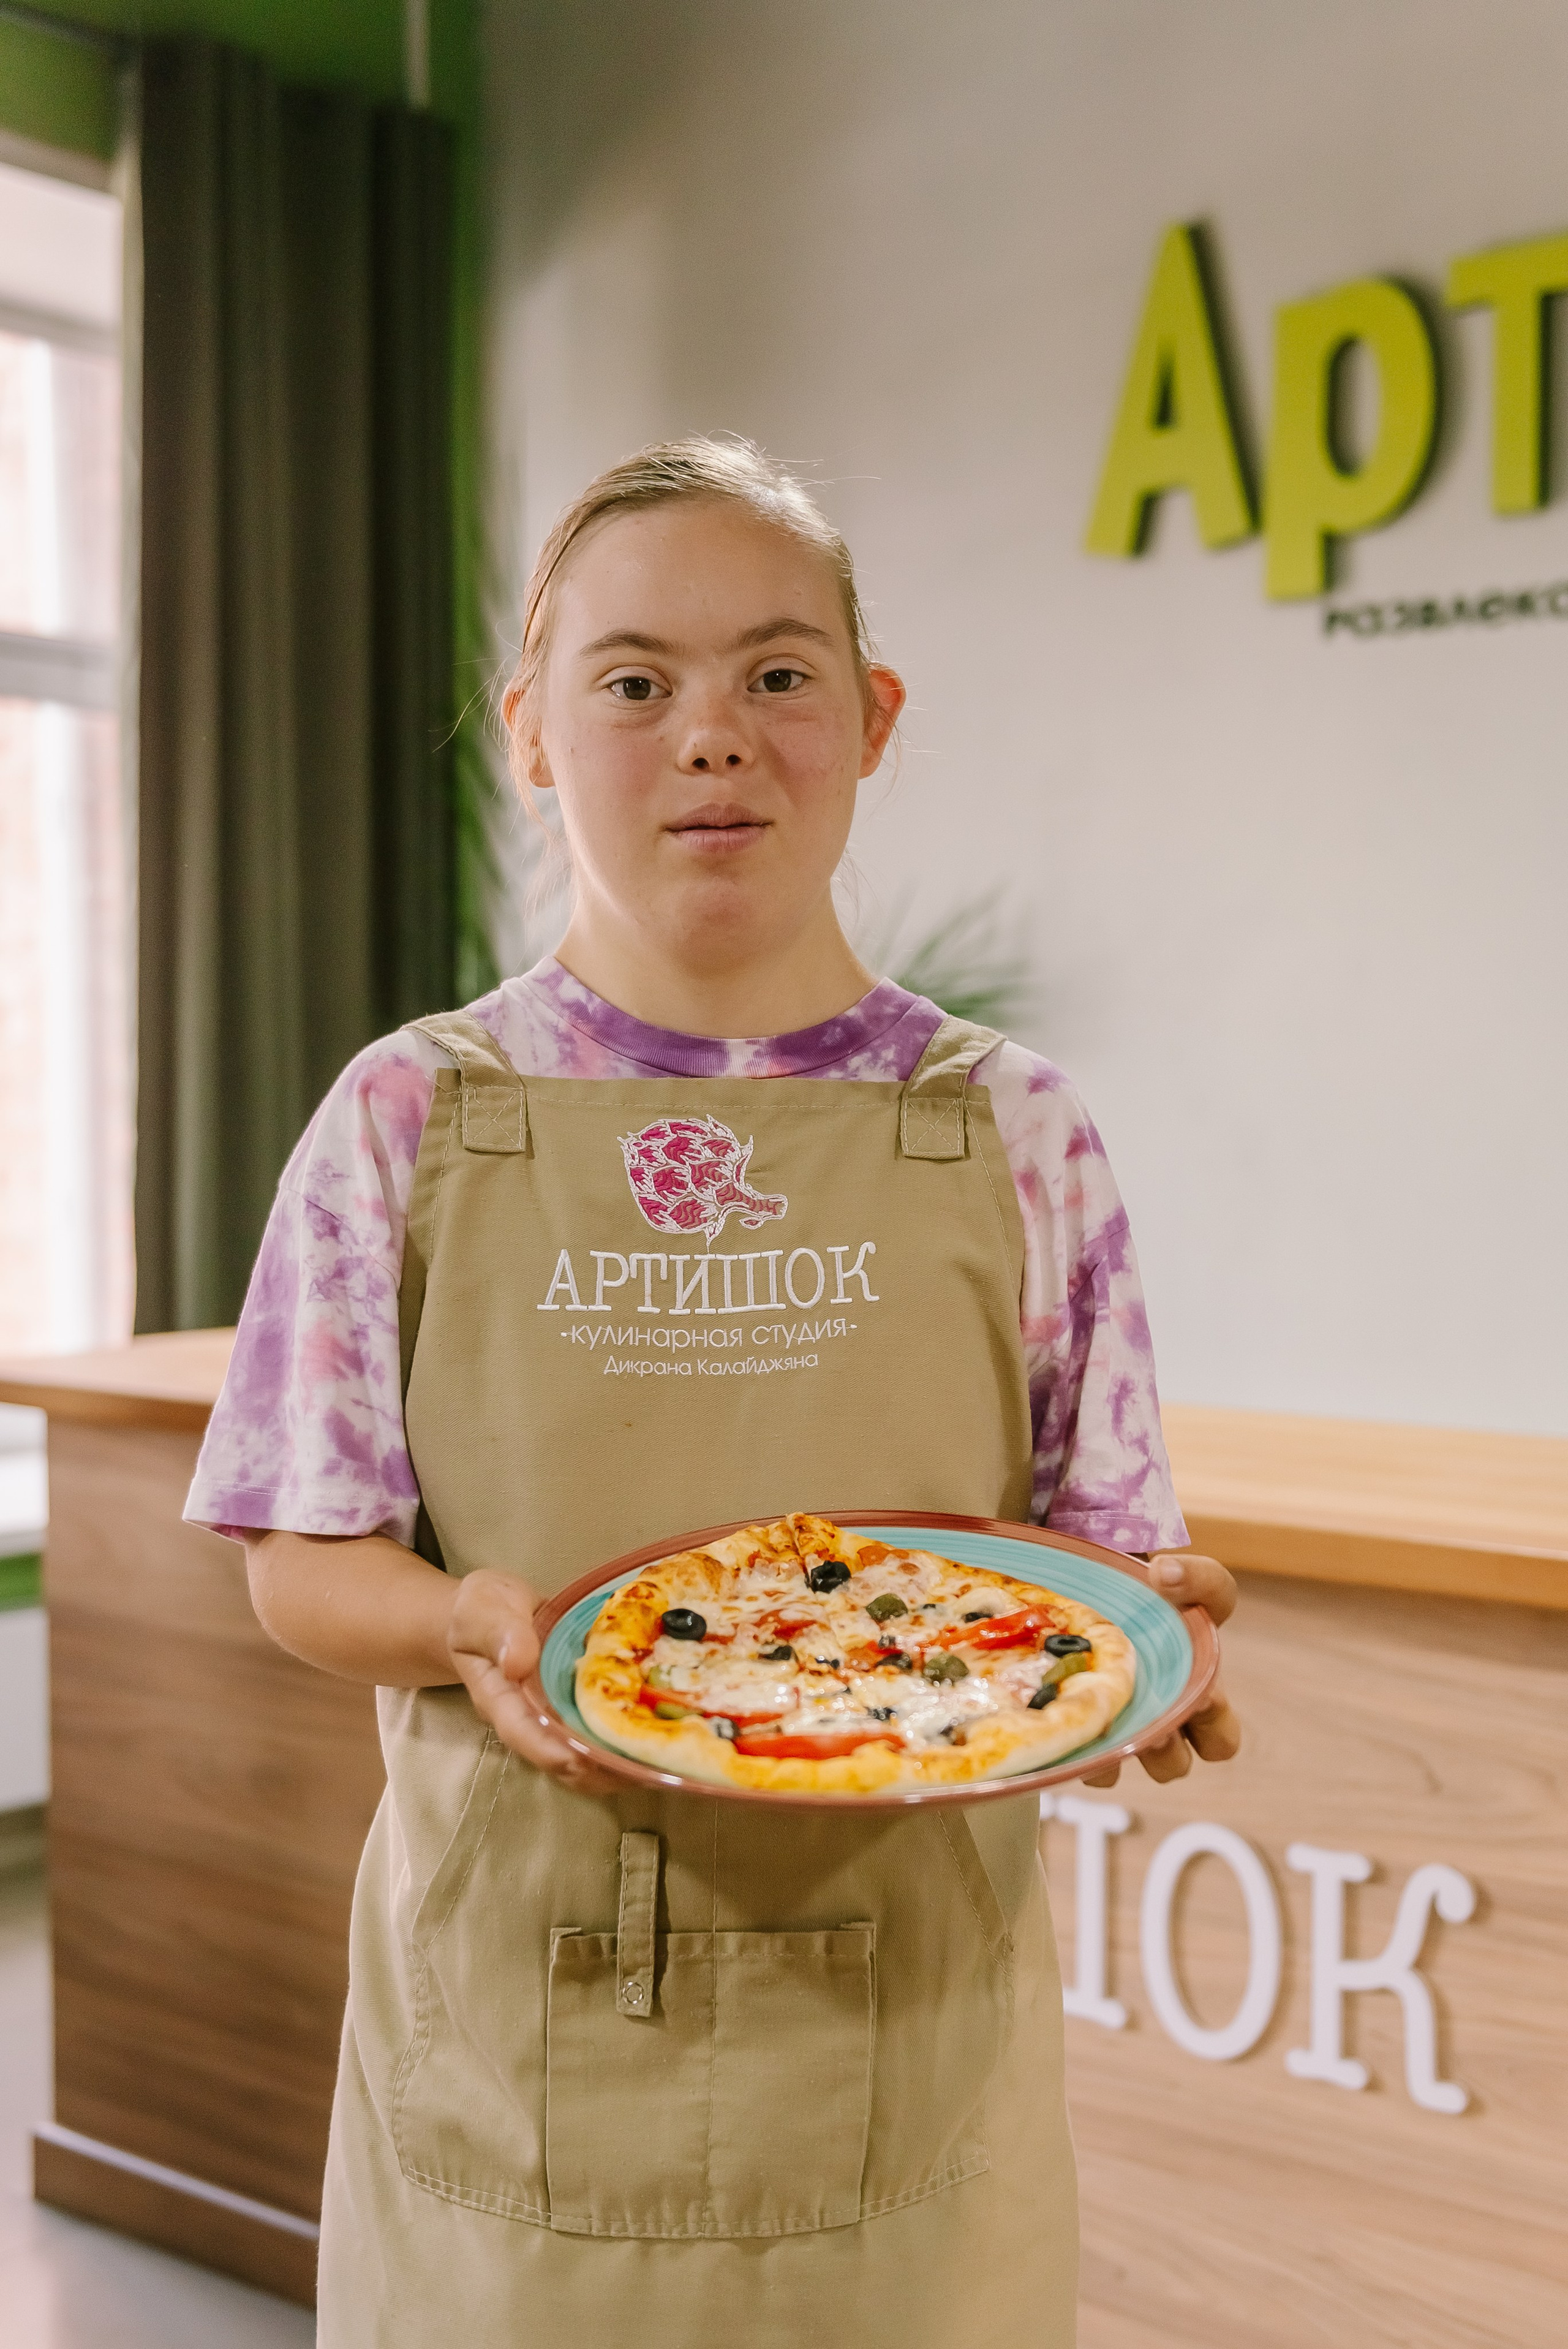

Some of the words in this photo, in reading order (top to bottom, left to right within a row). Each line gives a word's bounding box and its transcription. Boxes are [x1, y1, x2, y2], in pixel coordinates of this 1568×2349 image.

[537, 1241, 880, 1314] АРТИШОК
[603, 1355, 692, 1377] Дикрана
[697, 1354, 818, 1375] Калайджяна
